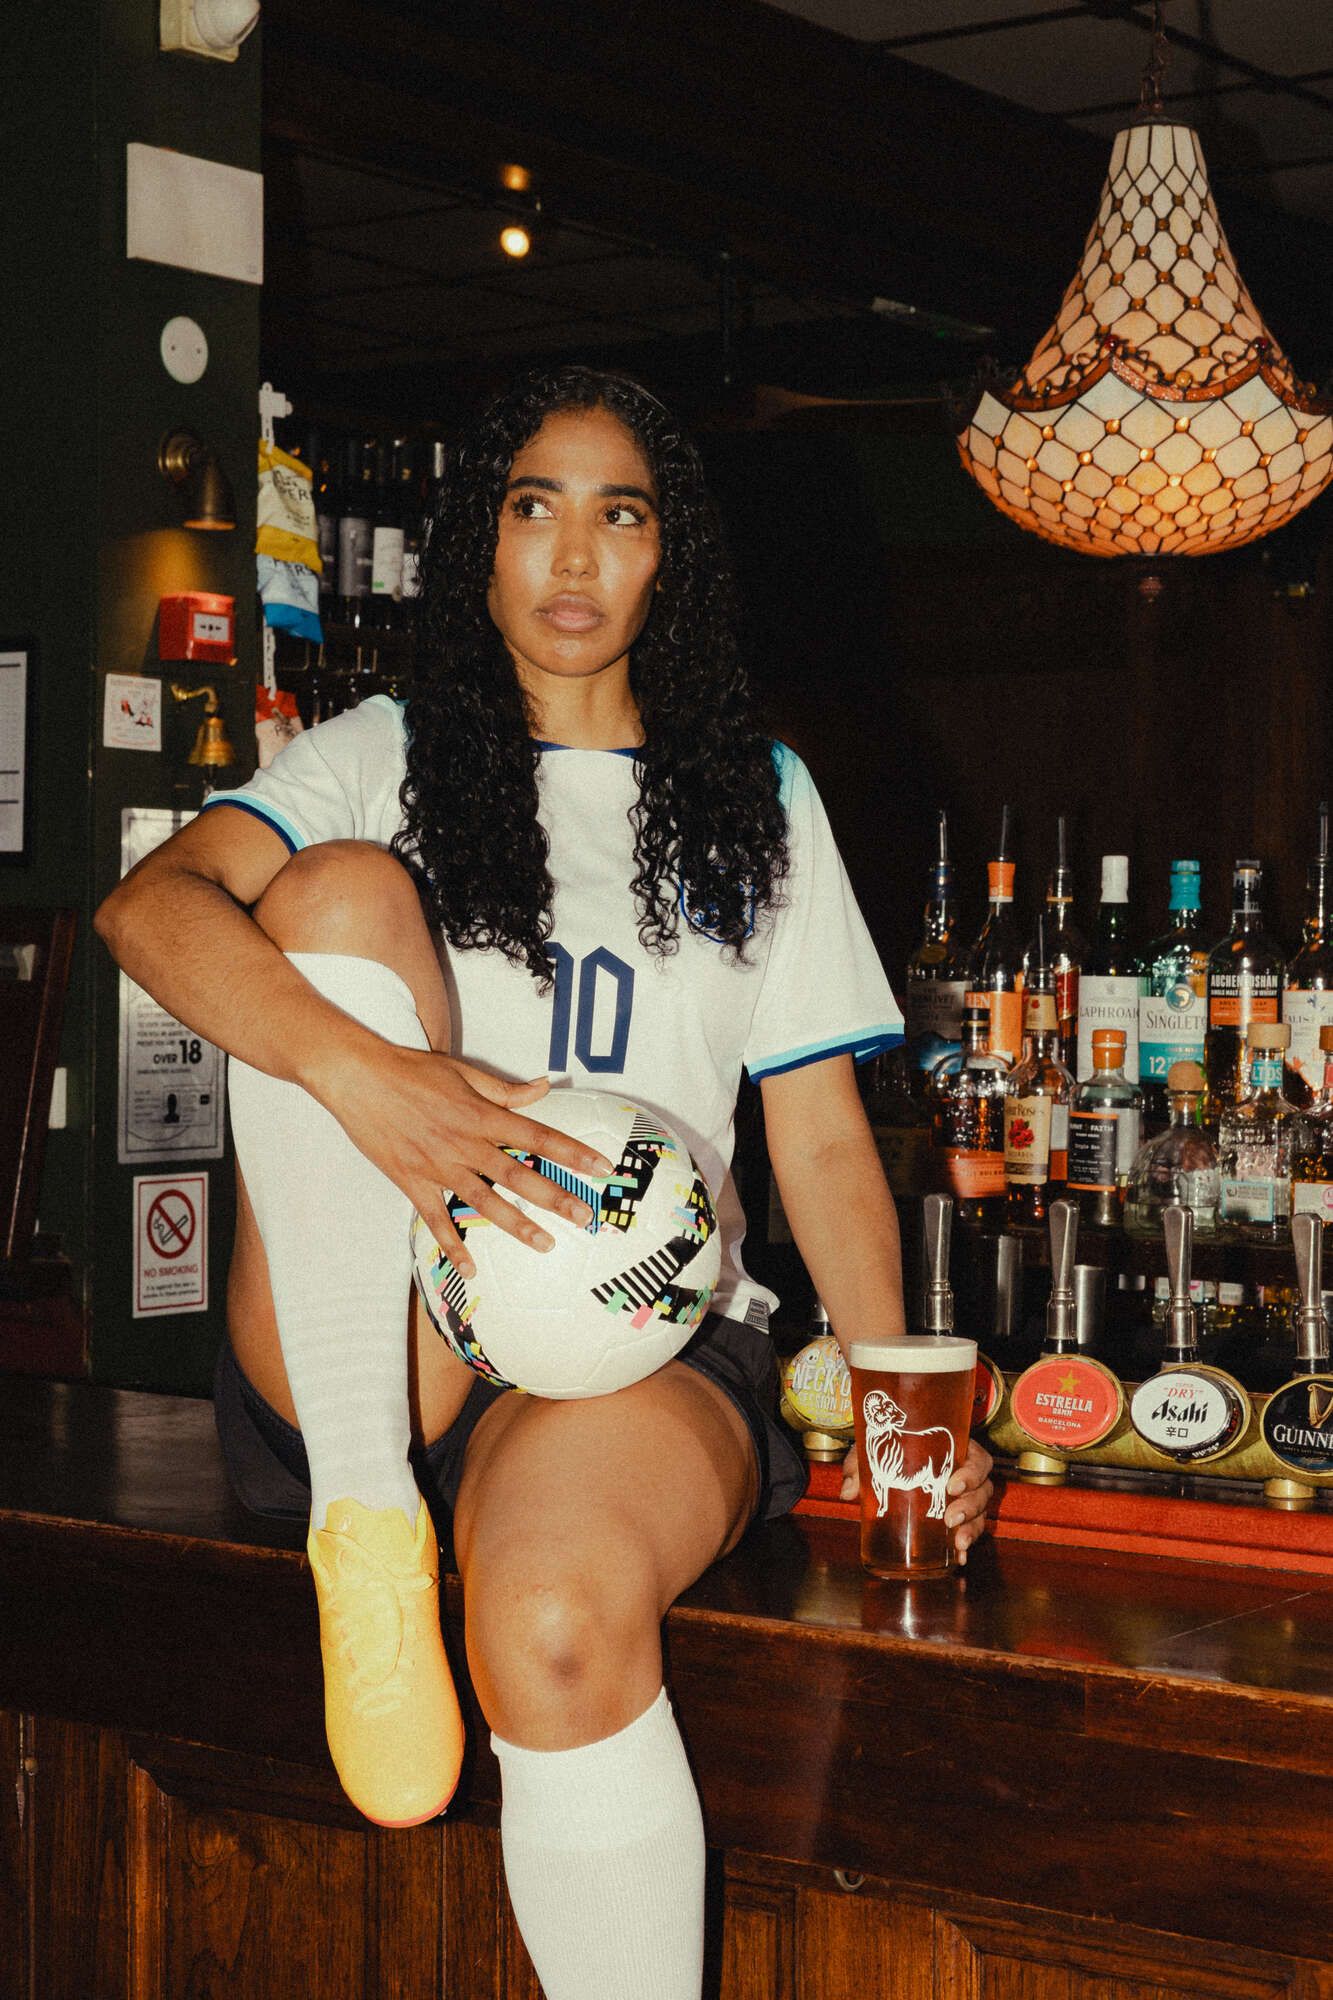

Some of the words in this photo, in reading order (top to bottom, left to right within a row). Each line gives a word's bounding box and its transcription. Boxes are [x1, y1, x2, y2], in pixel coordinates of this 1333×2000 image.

[1210, 974, 1279, 988] AUCHENOSHAN
[544, 941, 636, 1075] 10
[153, 1053, 178, 1065] OVER
[179, 1039, 202, 1064] 18
[1149, 1056, 1166, 1075] 12
[144, 1269, 157, 1278] NO
[159, 1264, 198, 1276] SMOKING
[792, 1362, 839, 1395] NECK
[1035, 1393, 1093, 1413] ESTRELLA
[1151, 1398, 1209, 1424] Asahi
[1038, 1417, 1081, 1429] BARCELONA
[1165, 1426, 1189, 1439] 辛口
